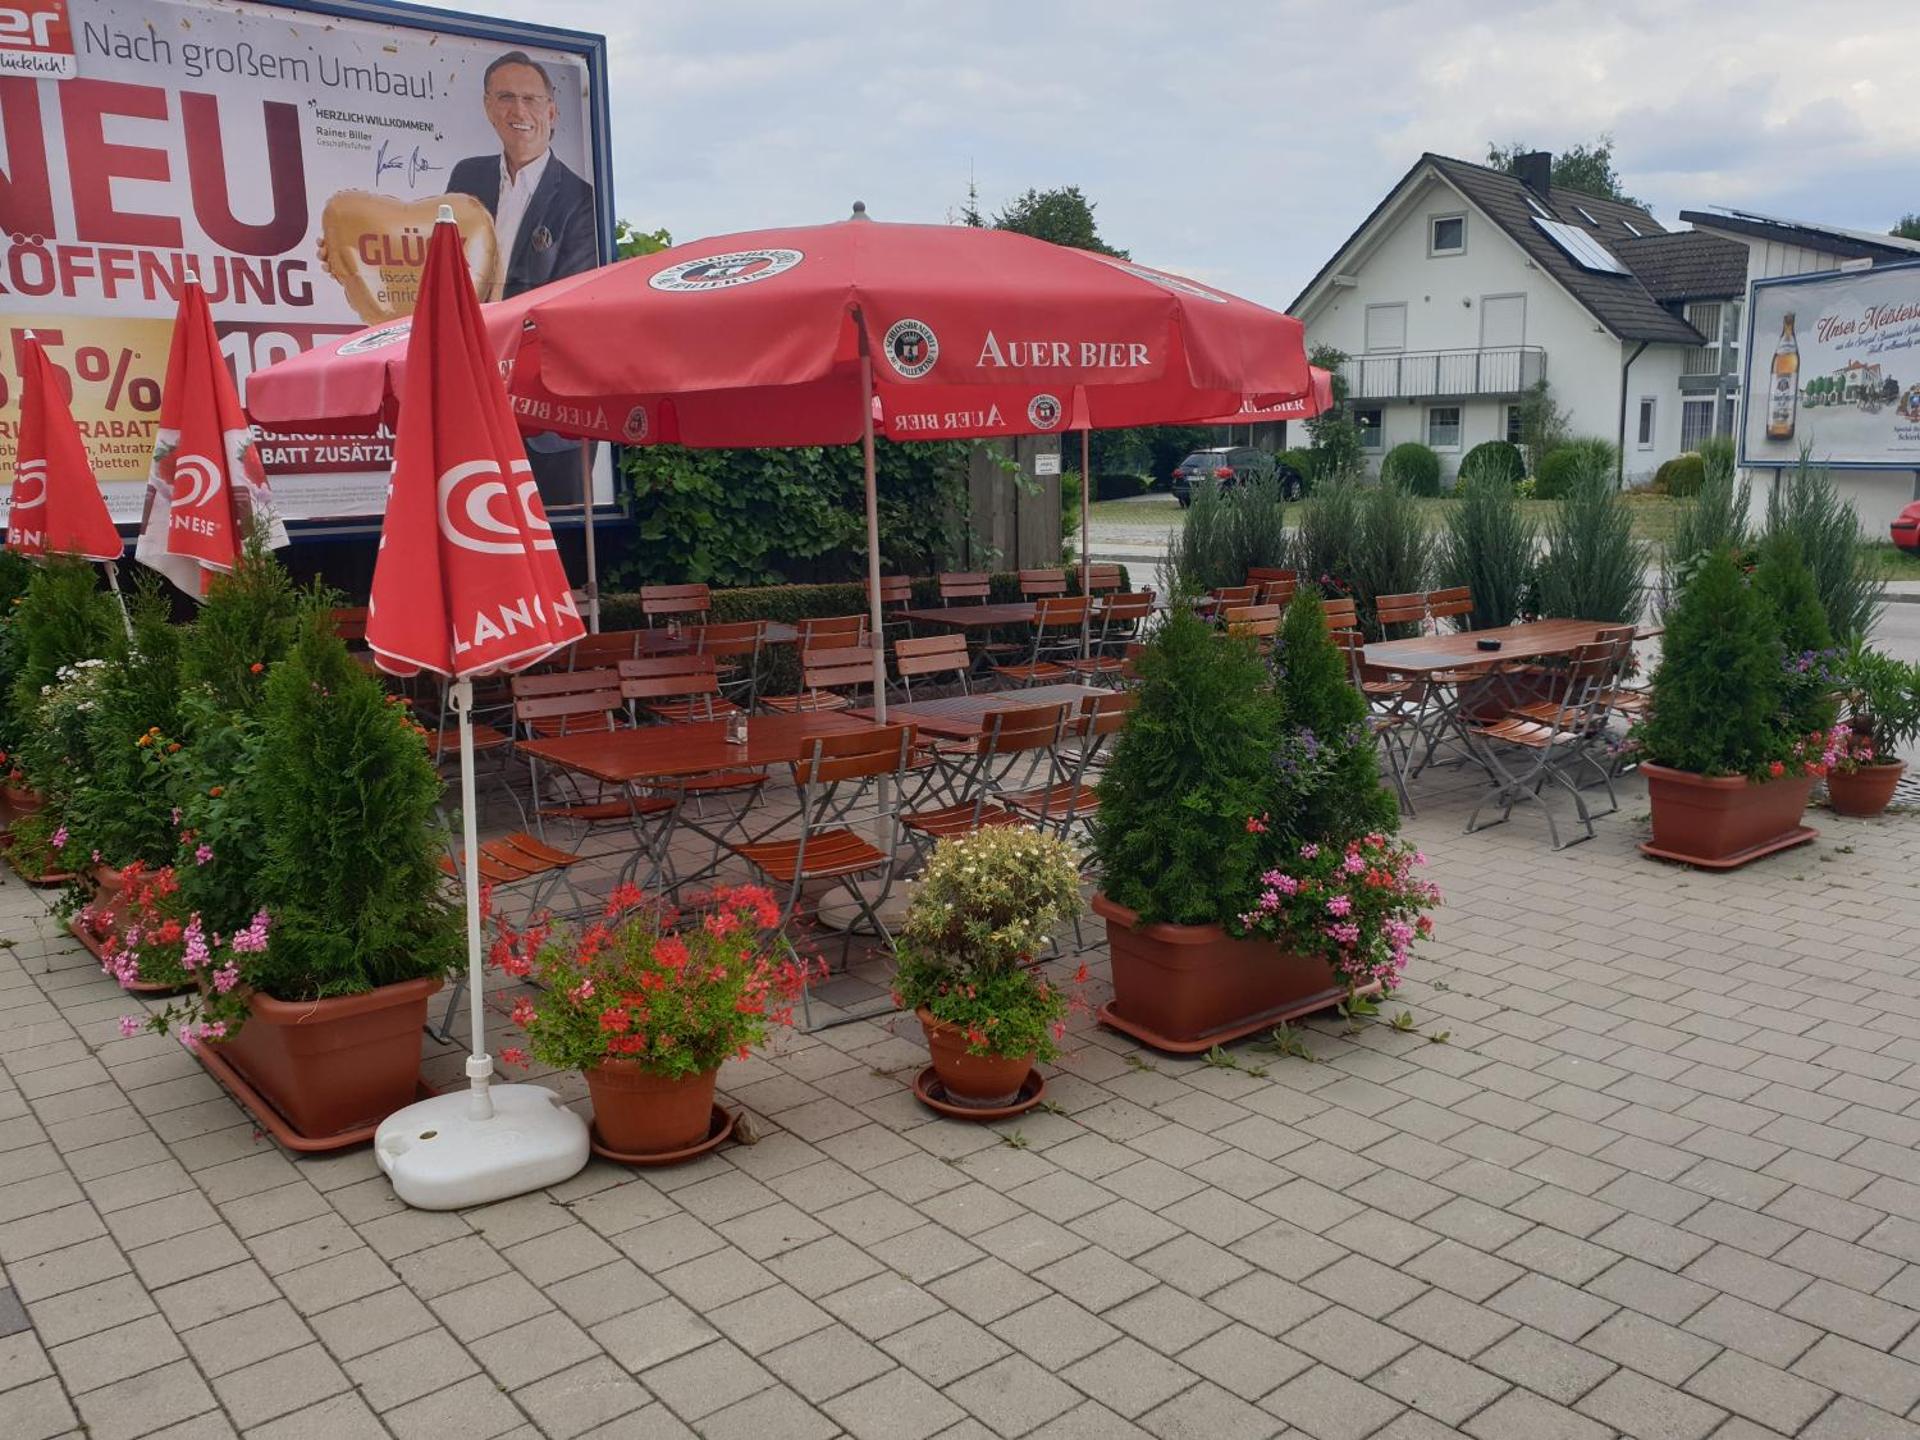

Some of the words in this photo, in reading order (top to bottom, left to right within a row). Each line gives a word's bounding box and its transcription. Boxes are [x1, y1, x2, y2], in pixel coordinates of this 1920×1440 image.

[84, 21, 172, 65] Nach
[182, 42, 310, 83] großem
[317, 54, 434, 100] Umbau!
[315, 109, 365, 123] HERZLICH
[365, 115, 434, 132] WILLKOMMEN!
[358, 227, 471, 267] GLÜ
[0, 232, 314, 307] ÖFFNUNG
[976, 329, 1072, 367] AUER
[1080, 342, 1152, 367] BIER
[1817, 314, 1857, 344] Unser
